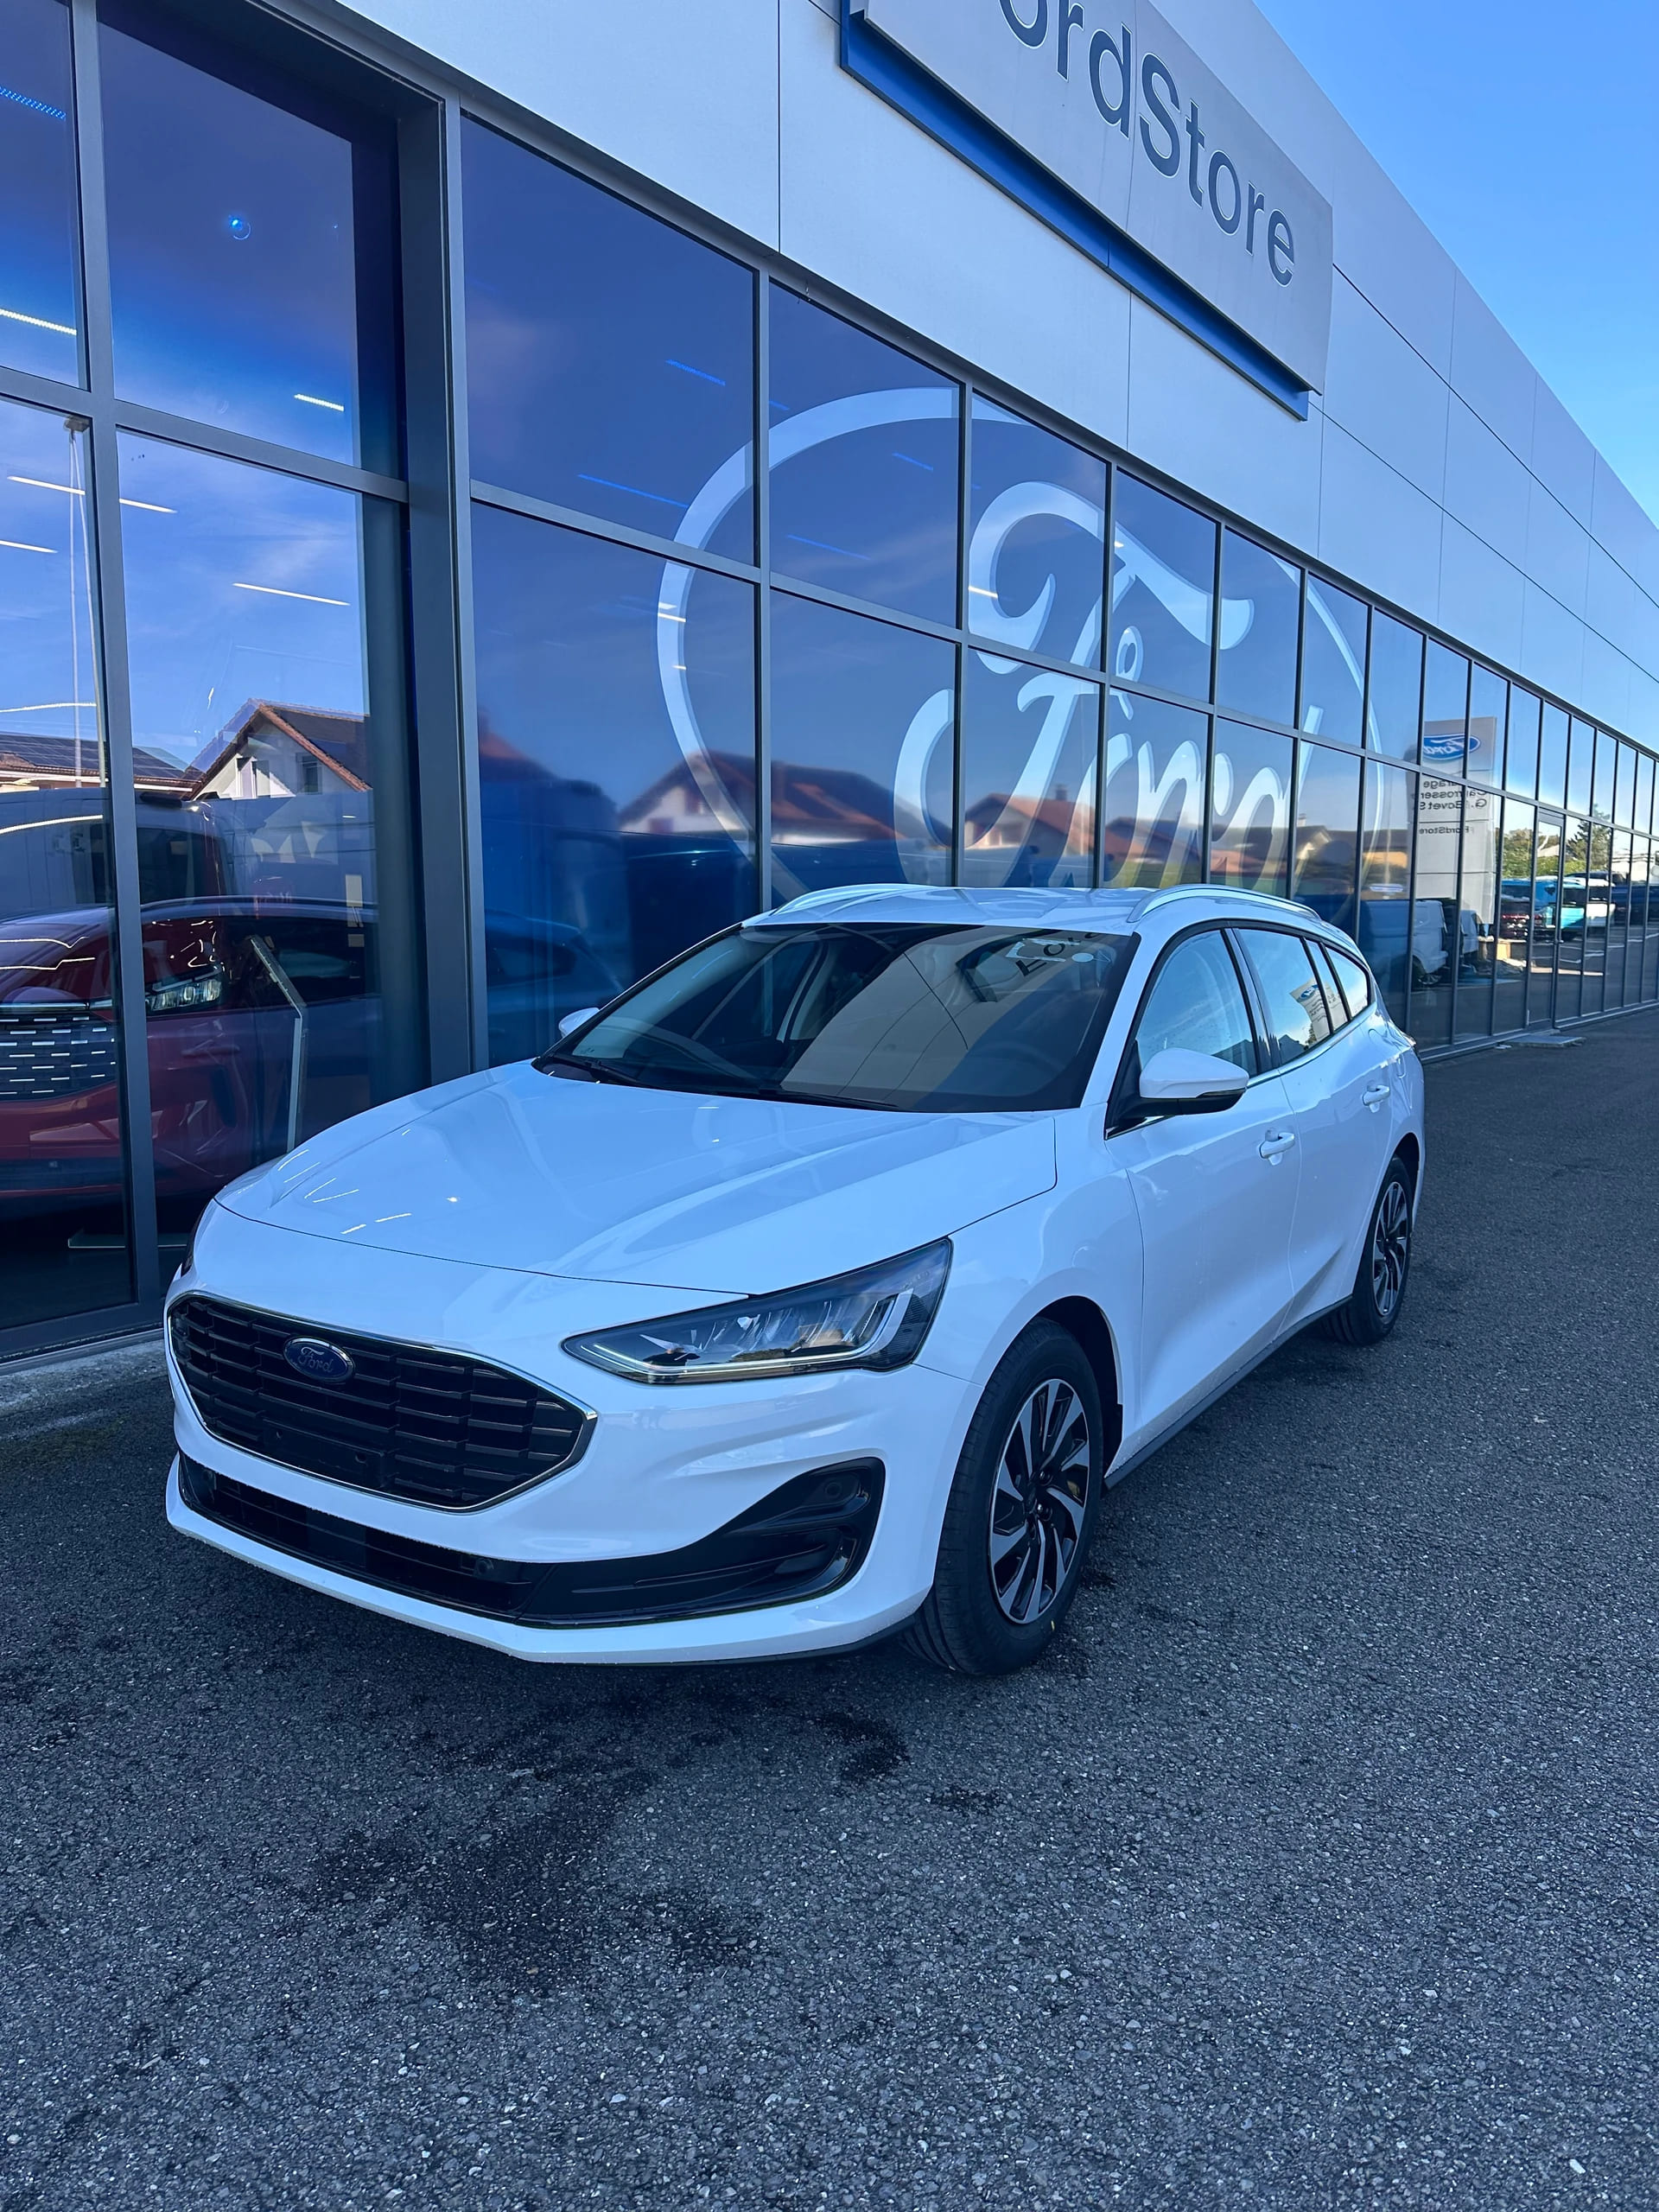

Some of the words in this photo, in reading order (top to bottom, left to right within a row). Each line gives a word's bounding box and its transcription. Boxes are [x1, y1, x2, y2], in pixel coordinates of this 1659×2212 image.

[999, 0, 1295, 288] ordStore
[895, 481, 1324, 888] Ford
[297, 1346, 334, 1373] Ford
